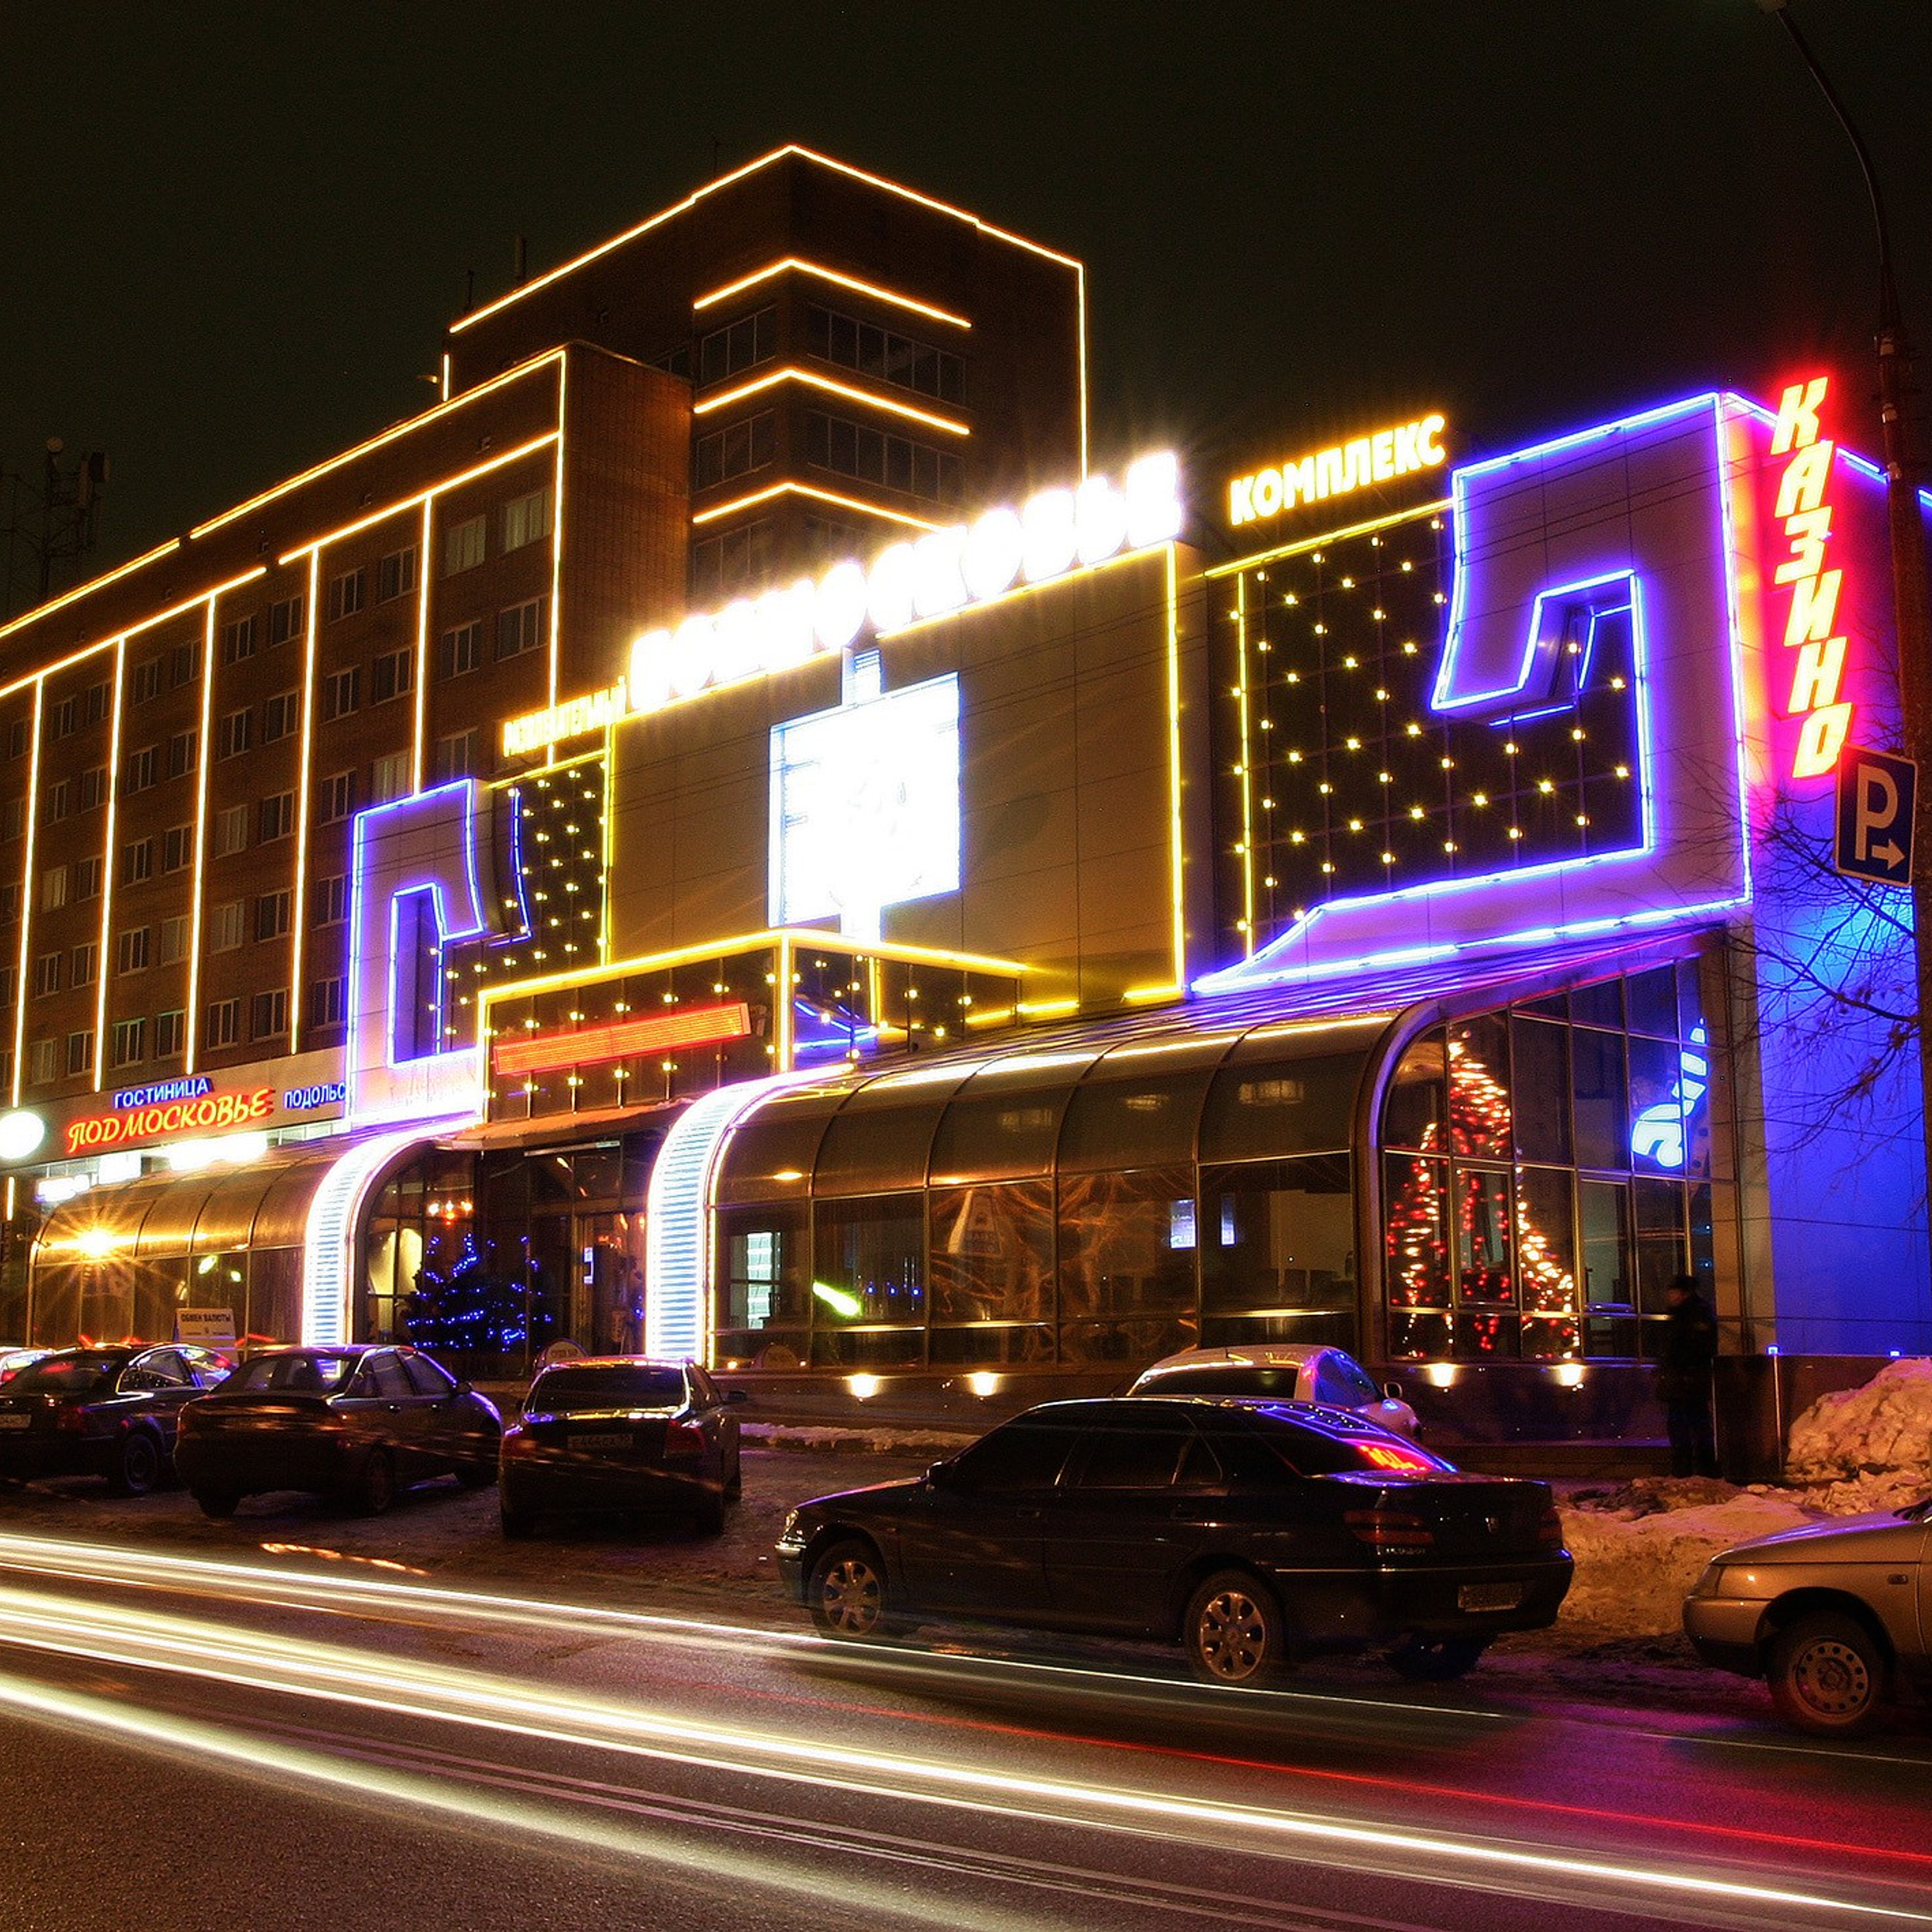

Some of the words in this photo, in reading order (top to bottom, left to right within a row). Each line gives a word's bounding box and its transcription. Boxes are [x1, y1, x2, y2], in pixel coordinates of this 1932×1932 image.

[1230, 414, 1446, 526] КОМПЛЕКС
[1770, 377, 1852, 778] КАЗИНО
[68, 1088, 272, 1152] ПОДМОСКОВЬЕ
[114, 1077, 212, 1109] ГОСТИНИЦА
